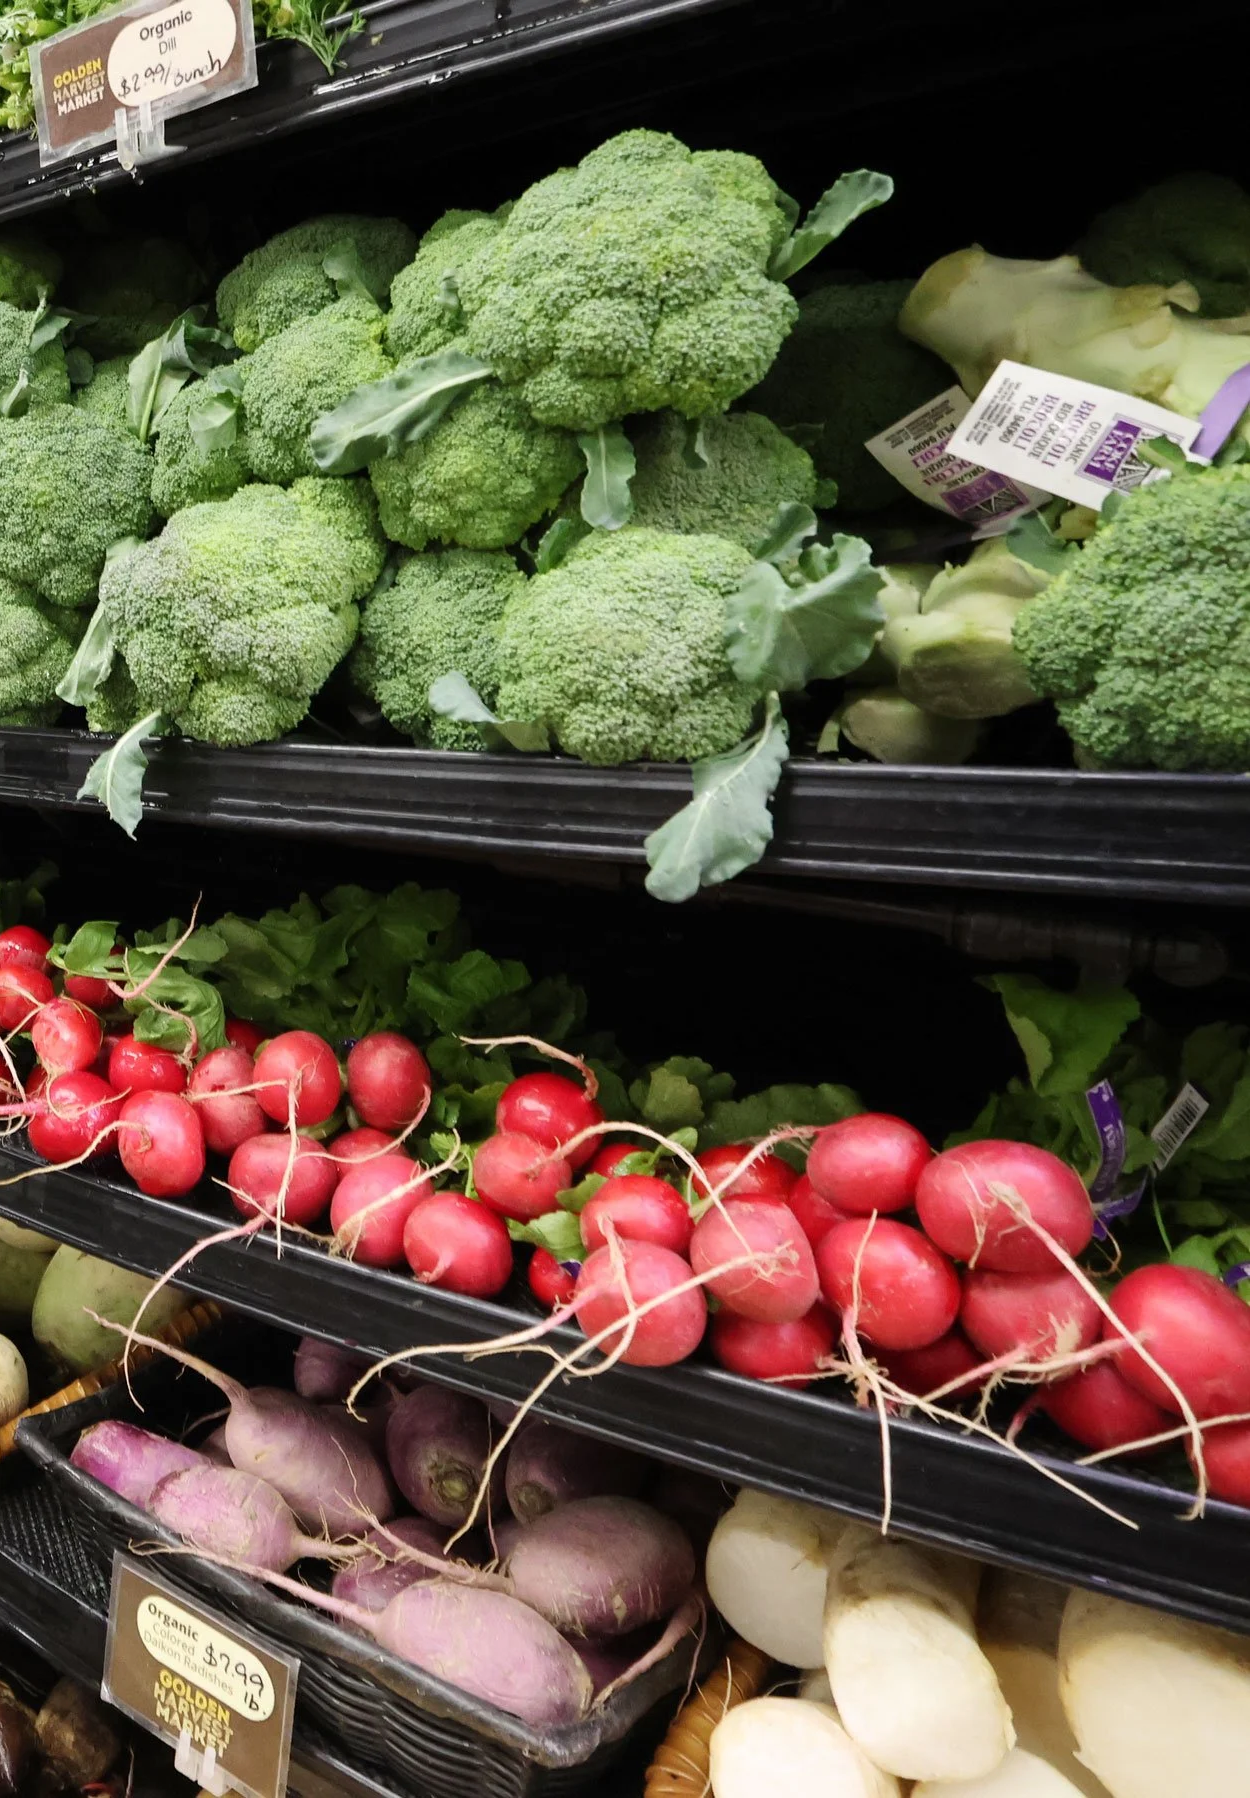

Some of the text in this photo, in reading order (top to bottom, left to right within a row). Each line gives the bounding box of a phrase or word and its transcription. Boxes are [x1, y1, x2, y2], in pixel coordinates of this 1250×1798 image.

[139, 9, 193, 41] Organic
[158, 38, 177, 56] Dill
[53, 71, 106, 104] HARVEST
[54, 58, 102, 88] GOLDEN
[57, 86, 105, 116] MARKET
[1013, 394, 1061, 451] BROCOLI
[1042, 400, 1096, 468] BROCCOLI
[1066, 422, 1102, 464] ORGANIC
[919, 455, 957, 478] OGIQUE
[147, 1601, 199, 1642] Organic
[152, 1621, 196, 1657] Colored
[143, 1630, 234, 1696] Daikon Radishes
[203, 1643, 264, 1698] $7.99
[153, 1680, 234, 1744] HARVEST
[159, 1668, 230, 1726] GOLDEN
[156, 1699, 228, 1759] MARKET
